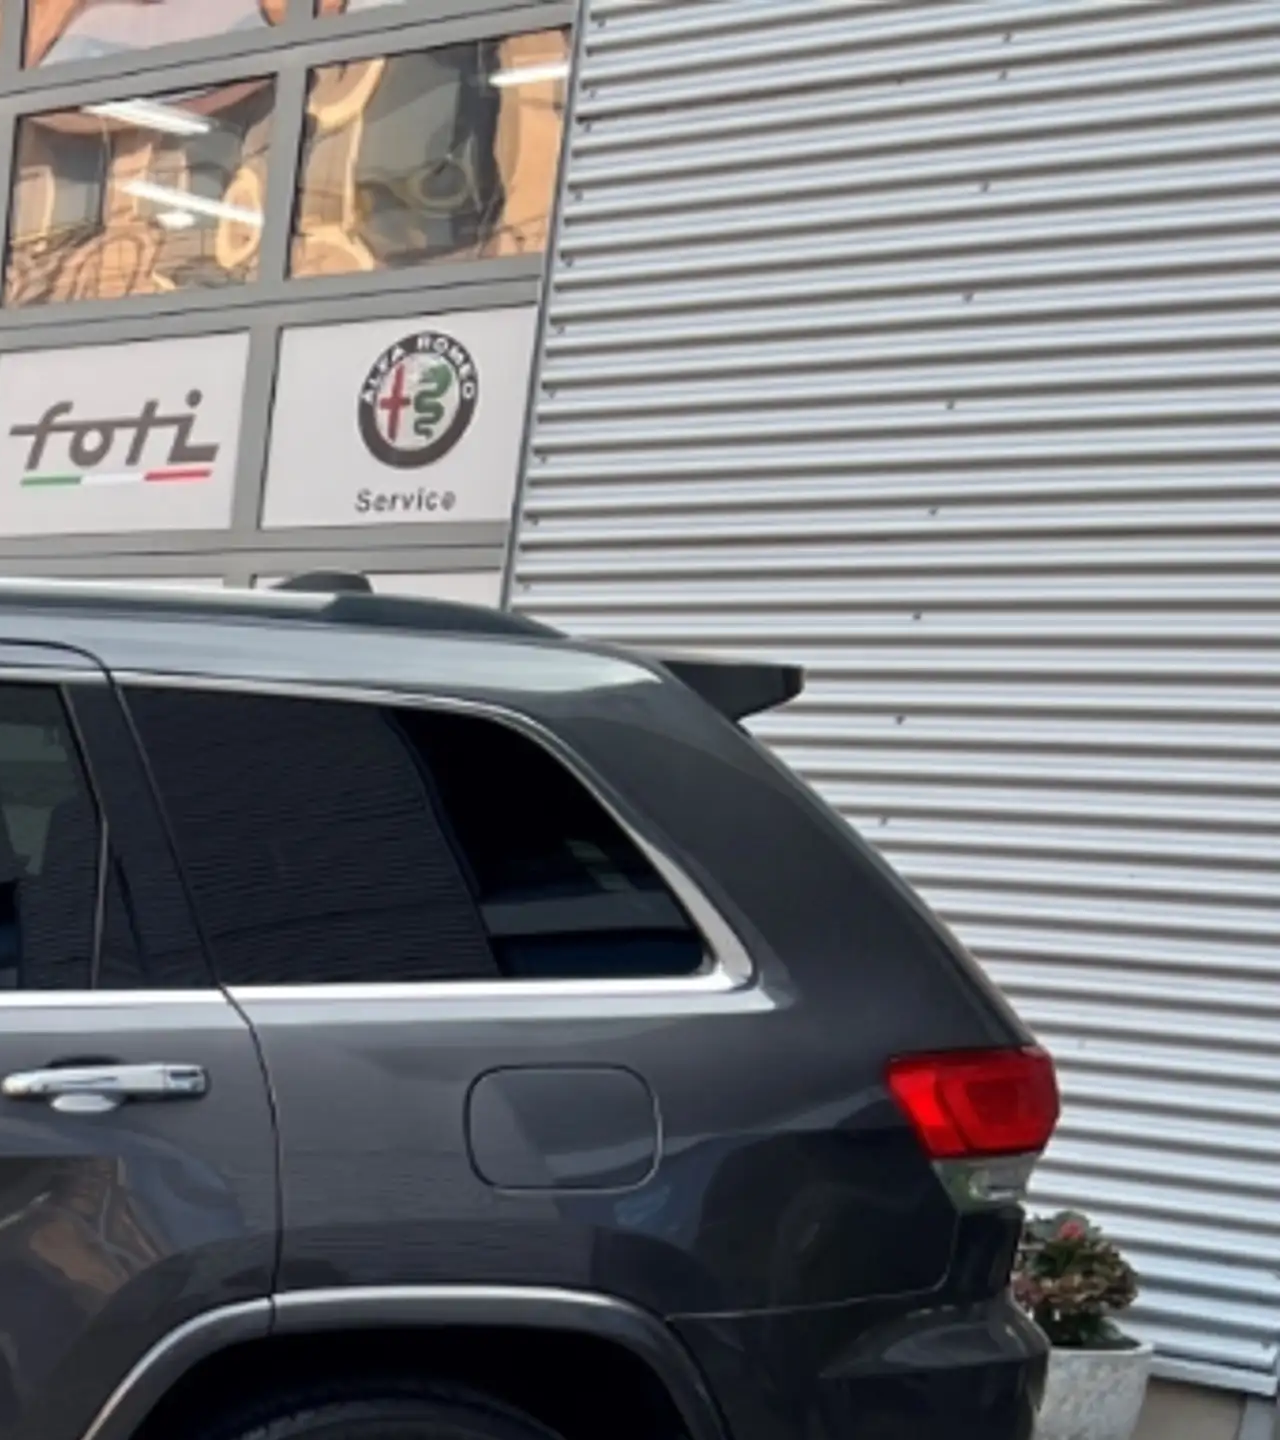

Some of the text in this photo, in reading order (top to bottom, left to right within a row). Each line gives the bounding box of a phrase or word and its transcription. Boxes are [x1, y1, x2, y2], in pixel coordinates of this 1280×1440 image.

[360, 335, 475, 405] ALFA ROMEO
[9, 389, 220, 471] foti
[354, 487, 457, 513] Service
